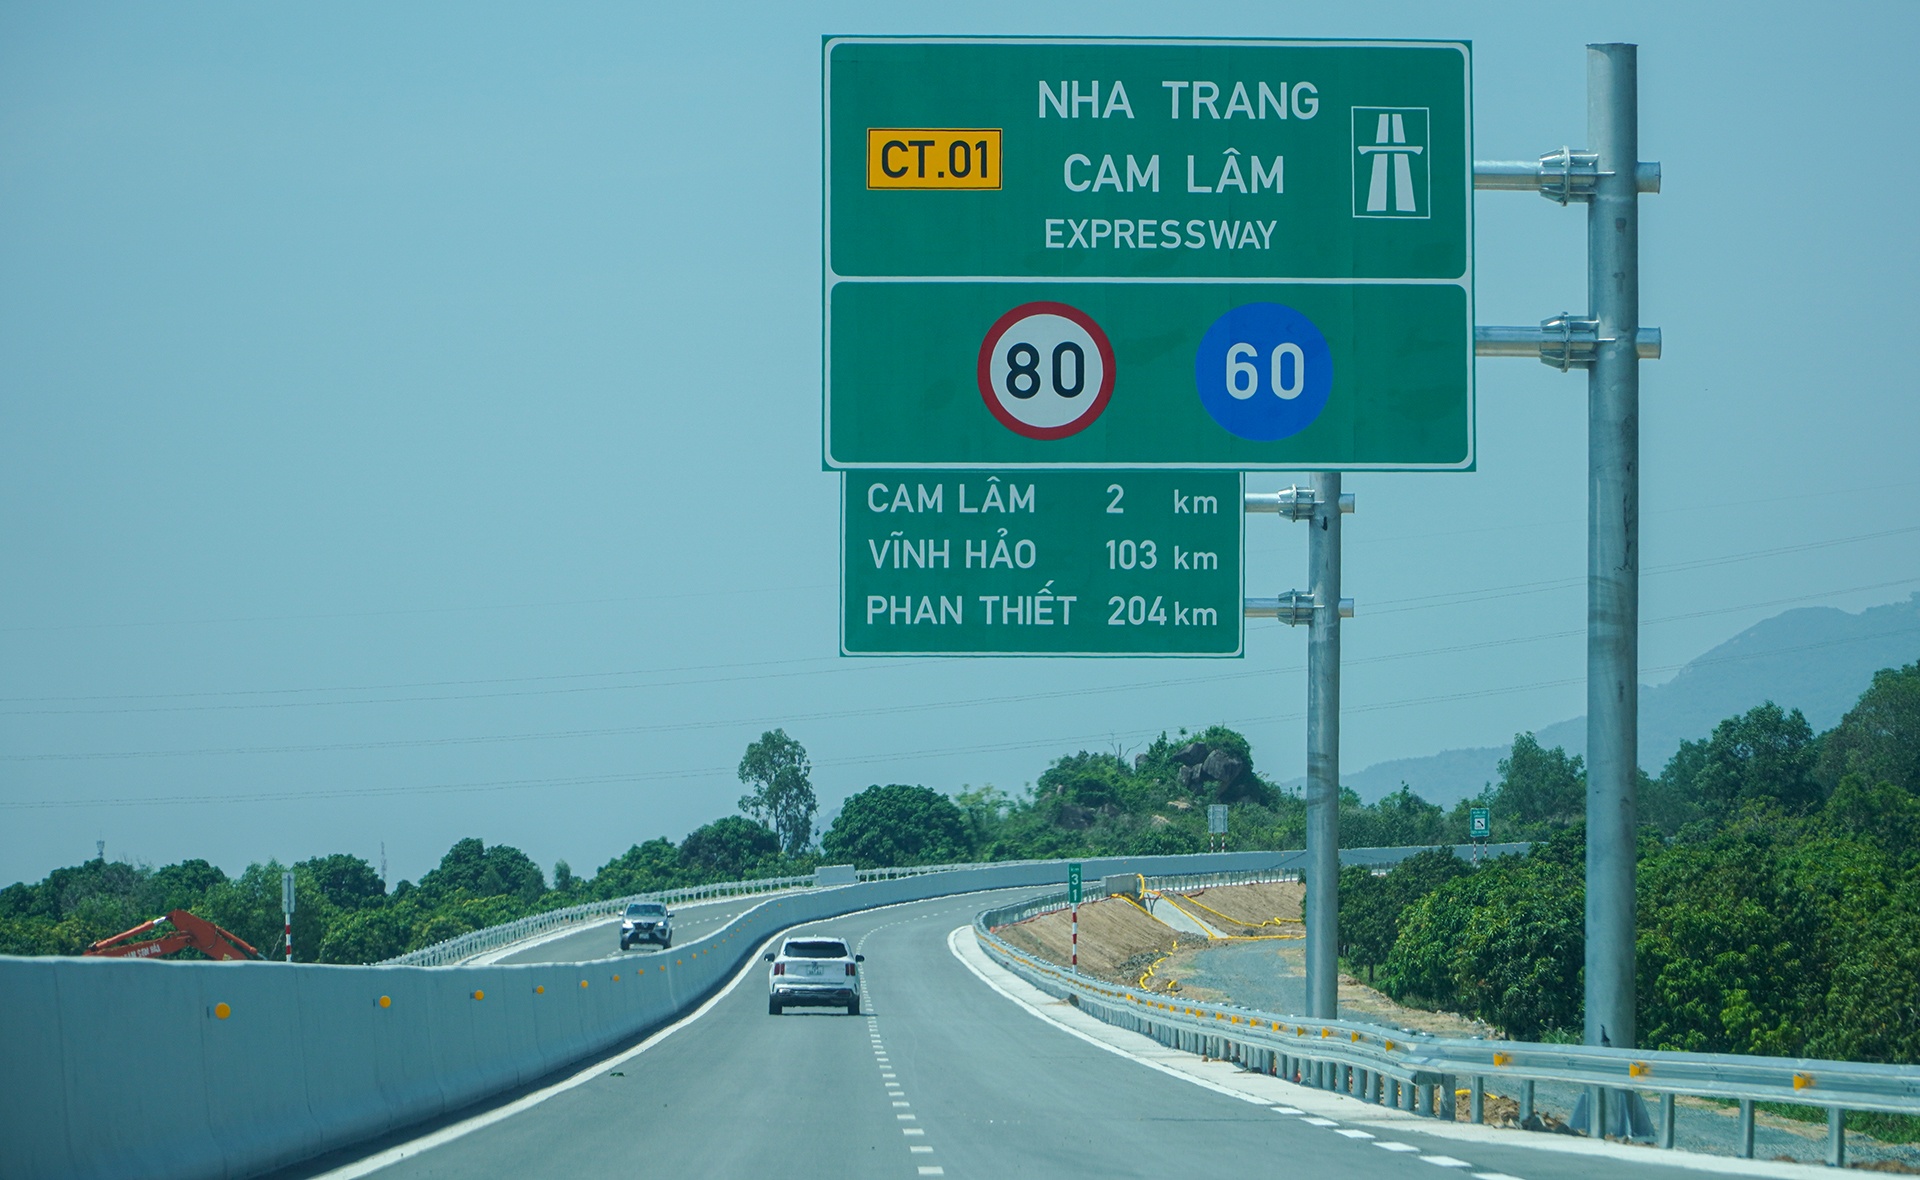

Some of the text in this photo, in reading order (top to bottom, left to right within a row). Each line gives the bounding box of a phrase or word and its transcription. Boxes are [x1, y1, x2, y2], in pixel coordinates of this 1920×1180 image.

[1038, 80, 1320, 120] NHA TRANG
[880, 139, 989, 179] CT.01
[1063, 147, 1285, 194] CAM LÂM
[1044, 218, 1278, 250] EXPRESSWAY
[1006, 341, 1085, 400] 80
[1225, 342, 1305, 400] 60
[867, 475, 1218, 514] CAM LÂM 2 km
[867, 527, 1218, 570] VĨNH HẢO 103 km
[866, 580, 1218, 626] PHAN THIẾT 204 km
[1071, 873, 1079, 885] 3
[1072, 889, 1078, 901] 1
